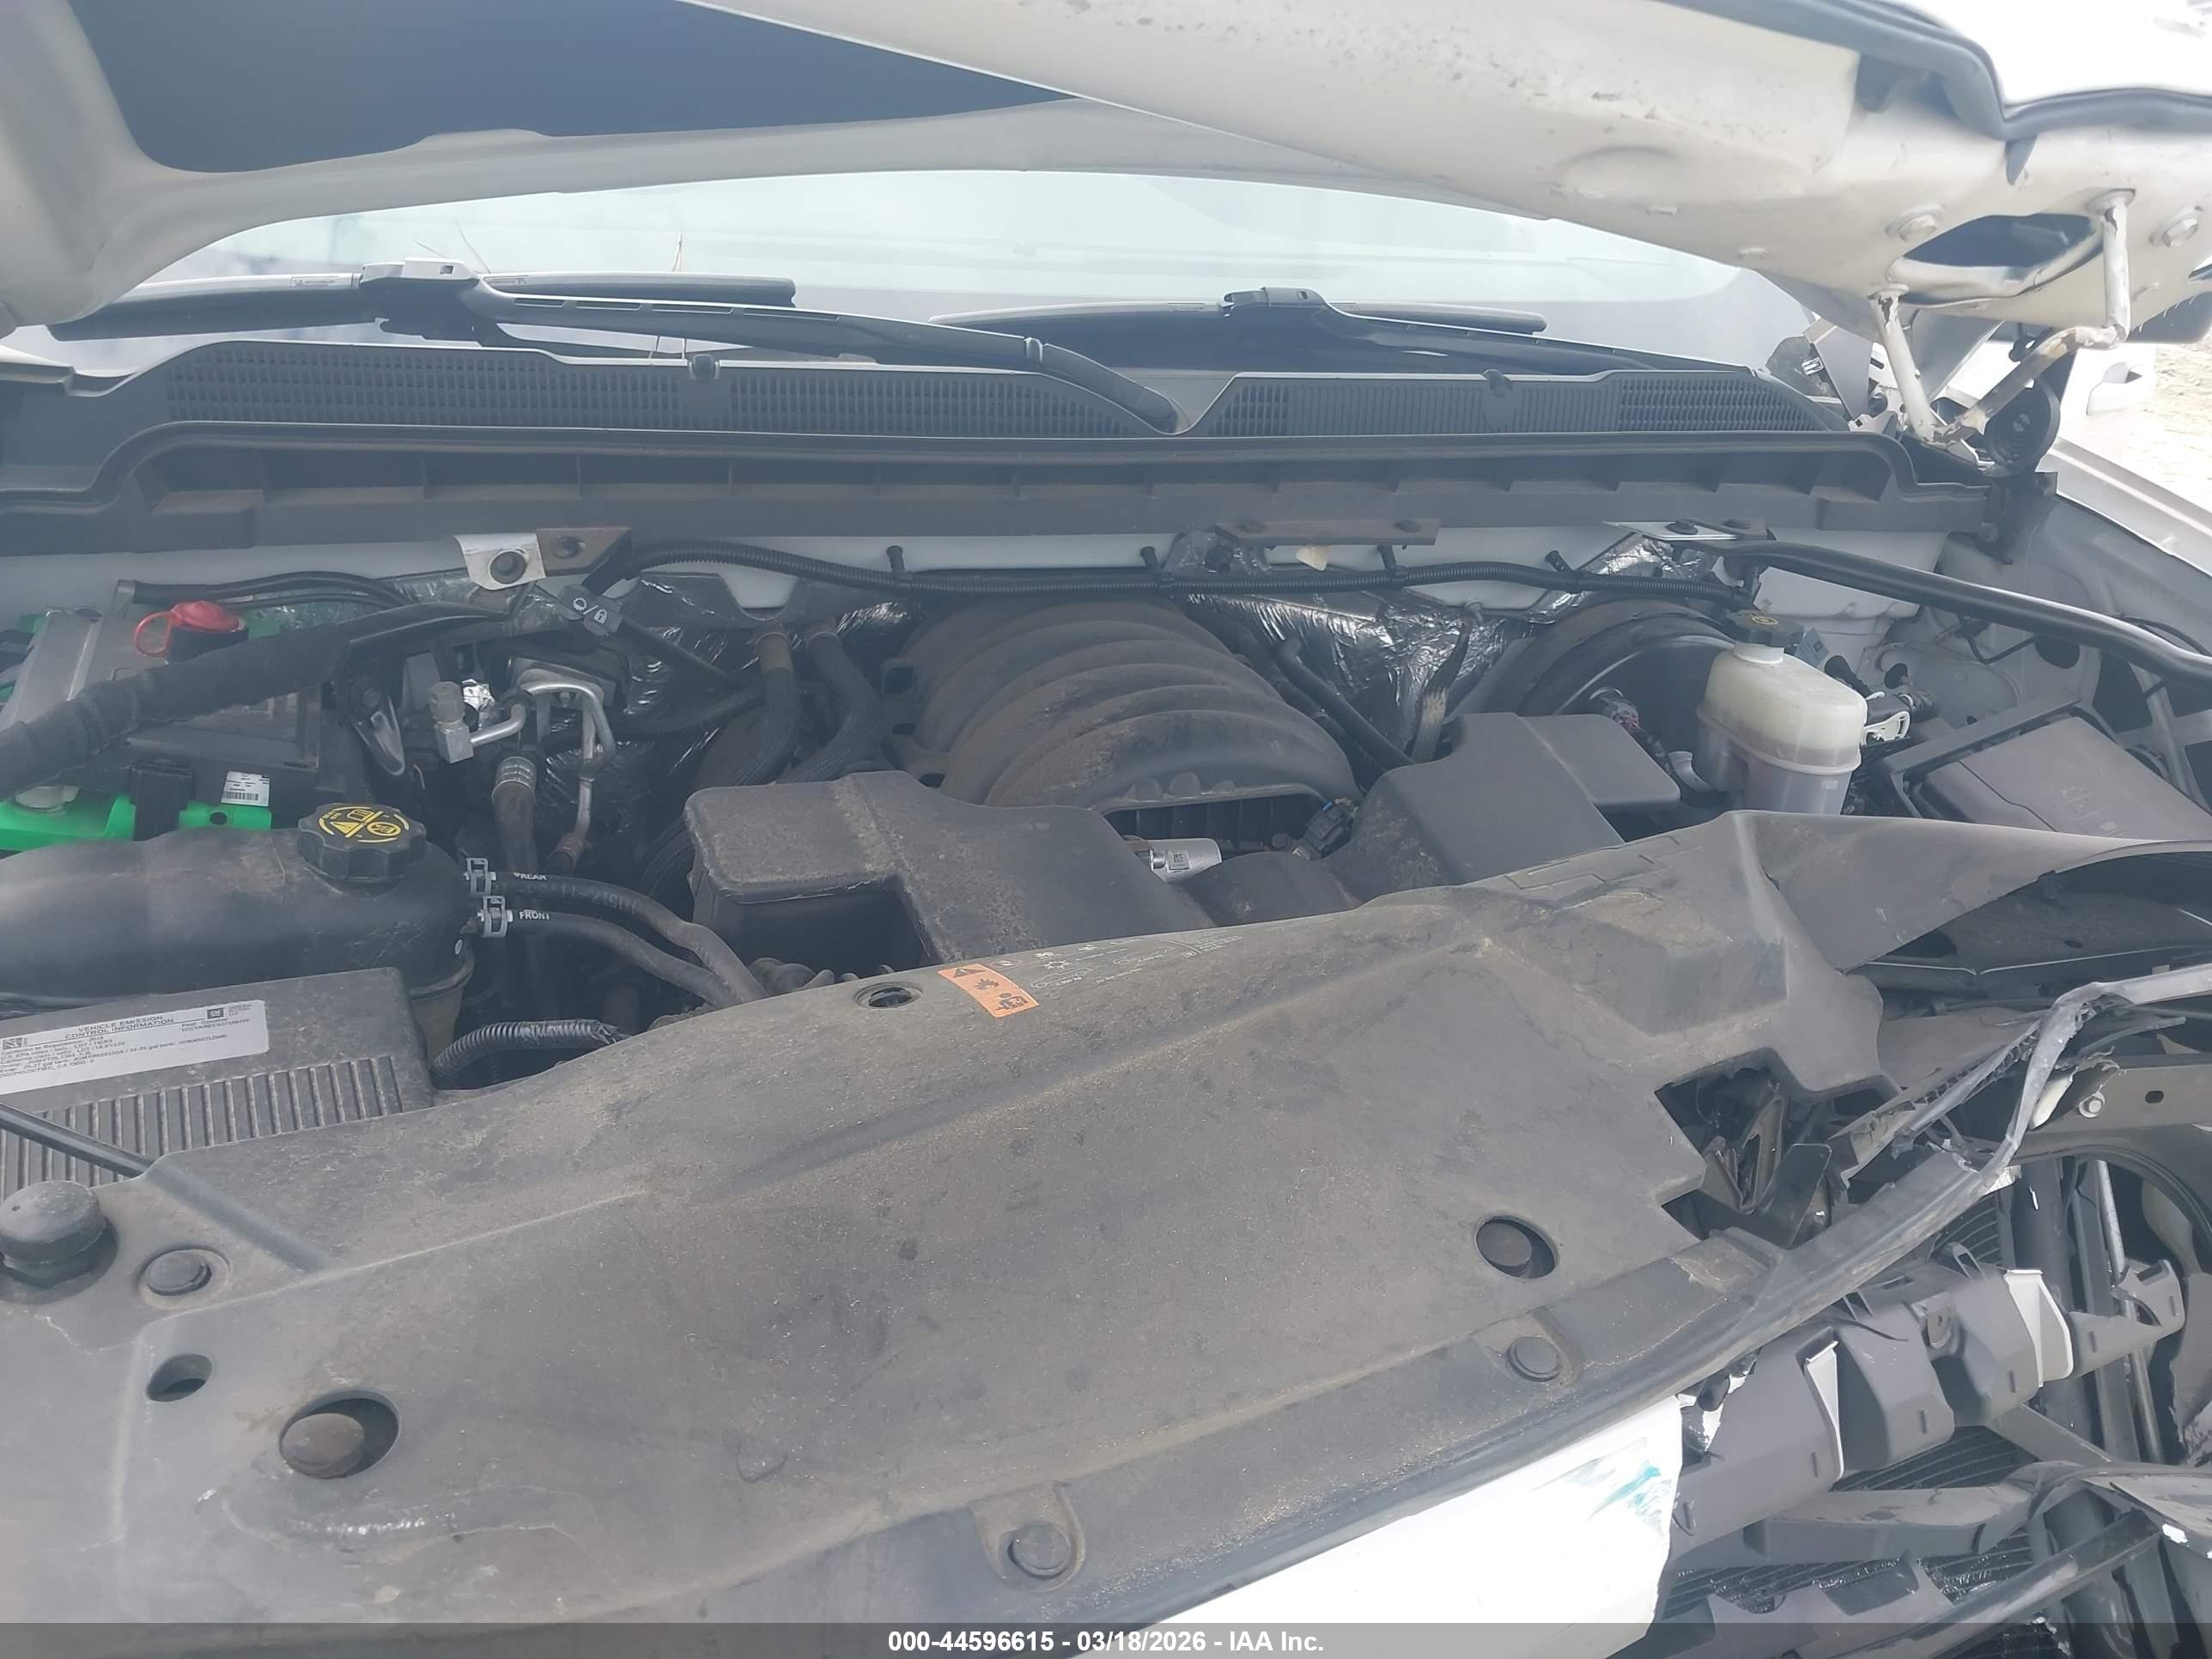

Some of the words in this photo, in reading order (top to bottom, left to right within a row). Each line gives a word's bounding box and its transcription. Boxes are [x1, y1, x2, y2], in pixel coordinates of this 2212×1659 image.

[520, 872, 549, 881] REAR
[520, 910, 550, 921] FRONT
[64, 1028, 110, 1039] CONTROL
[112, 1018, 173, 1033] INFORMATION
[78, 1022, 118, 1032] VEHICLE
[119, 1016, 163, 1026] EMISSION
